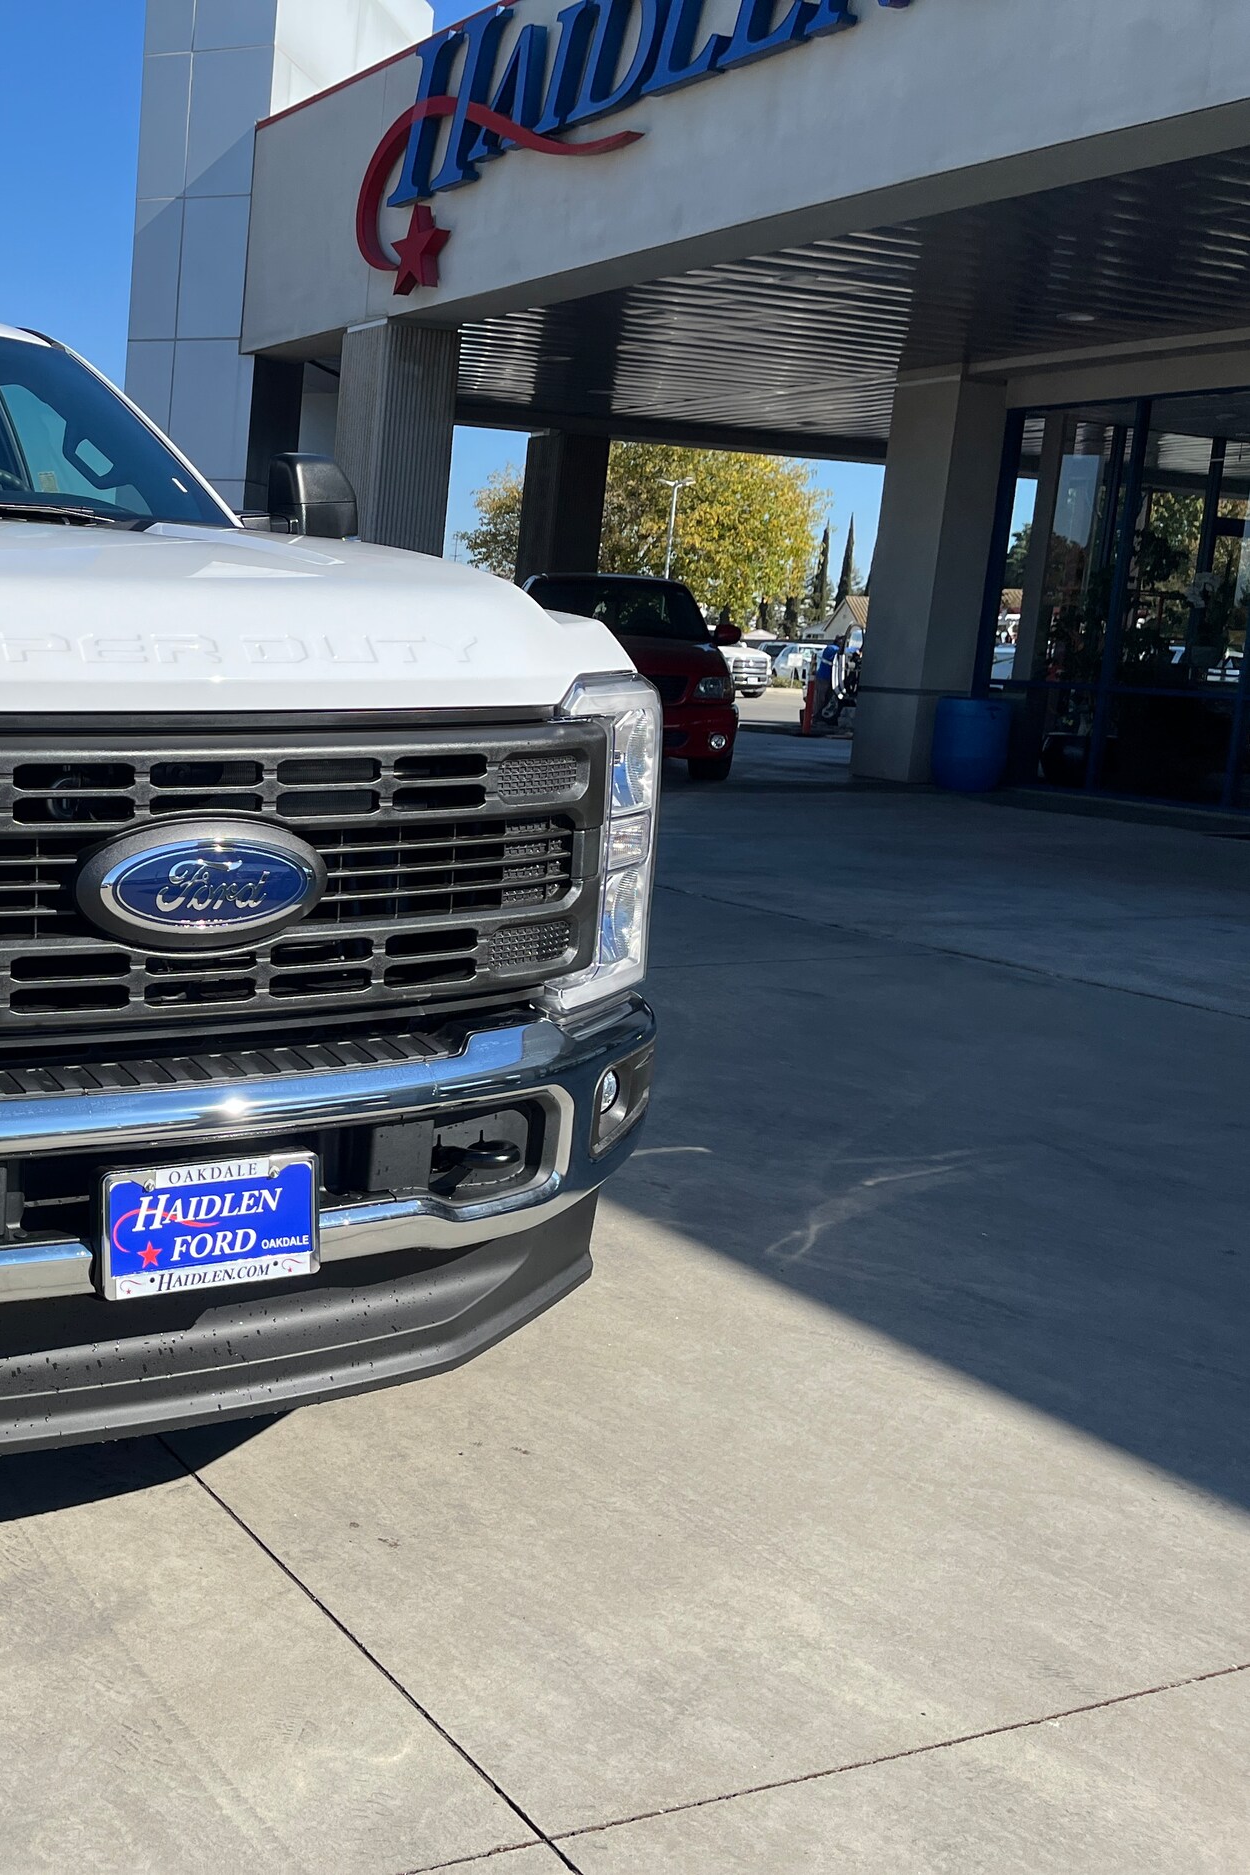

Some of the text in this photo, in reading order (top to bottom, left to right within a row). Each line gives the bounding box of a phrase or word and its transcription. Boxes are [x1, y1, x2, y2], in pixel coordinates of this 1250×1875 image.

[240, 633, 479, 664] DUTY
[156, 859, 271, 912] Ford
[168, 1162, 258, 1185] OAKDALE
[132, 1187, 283, 1232] HAIDLEN
[170, 1228, 310, 1262] FORD OAKDALE
[157, 1263, 271, 1292] HAIDLEN.COM
